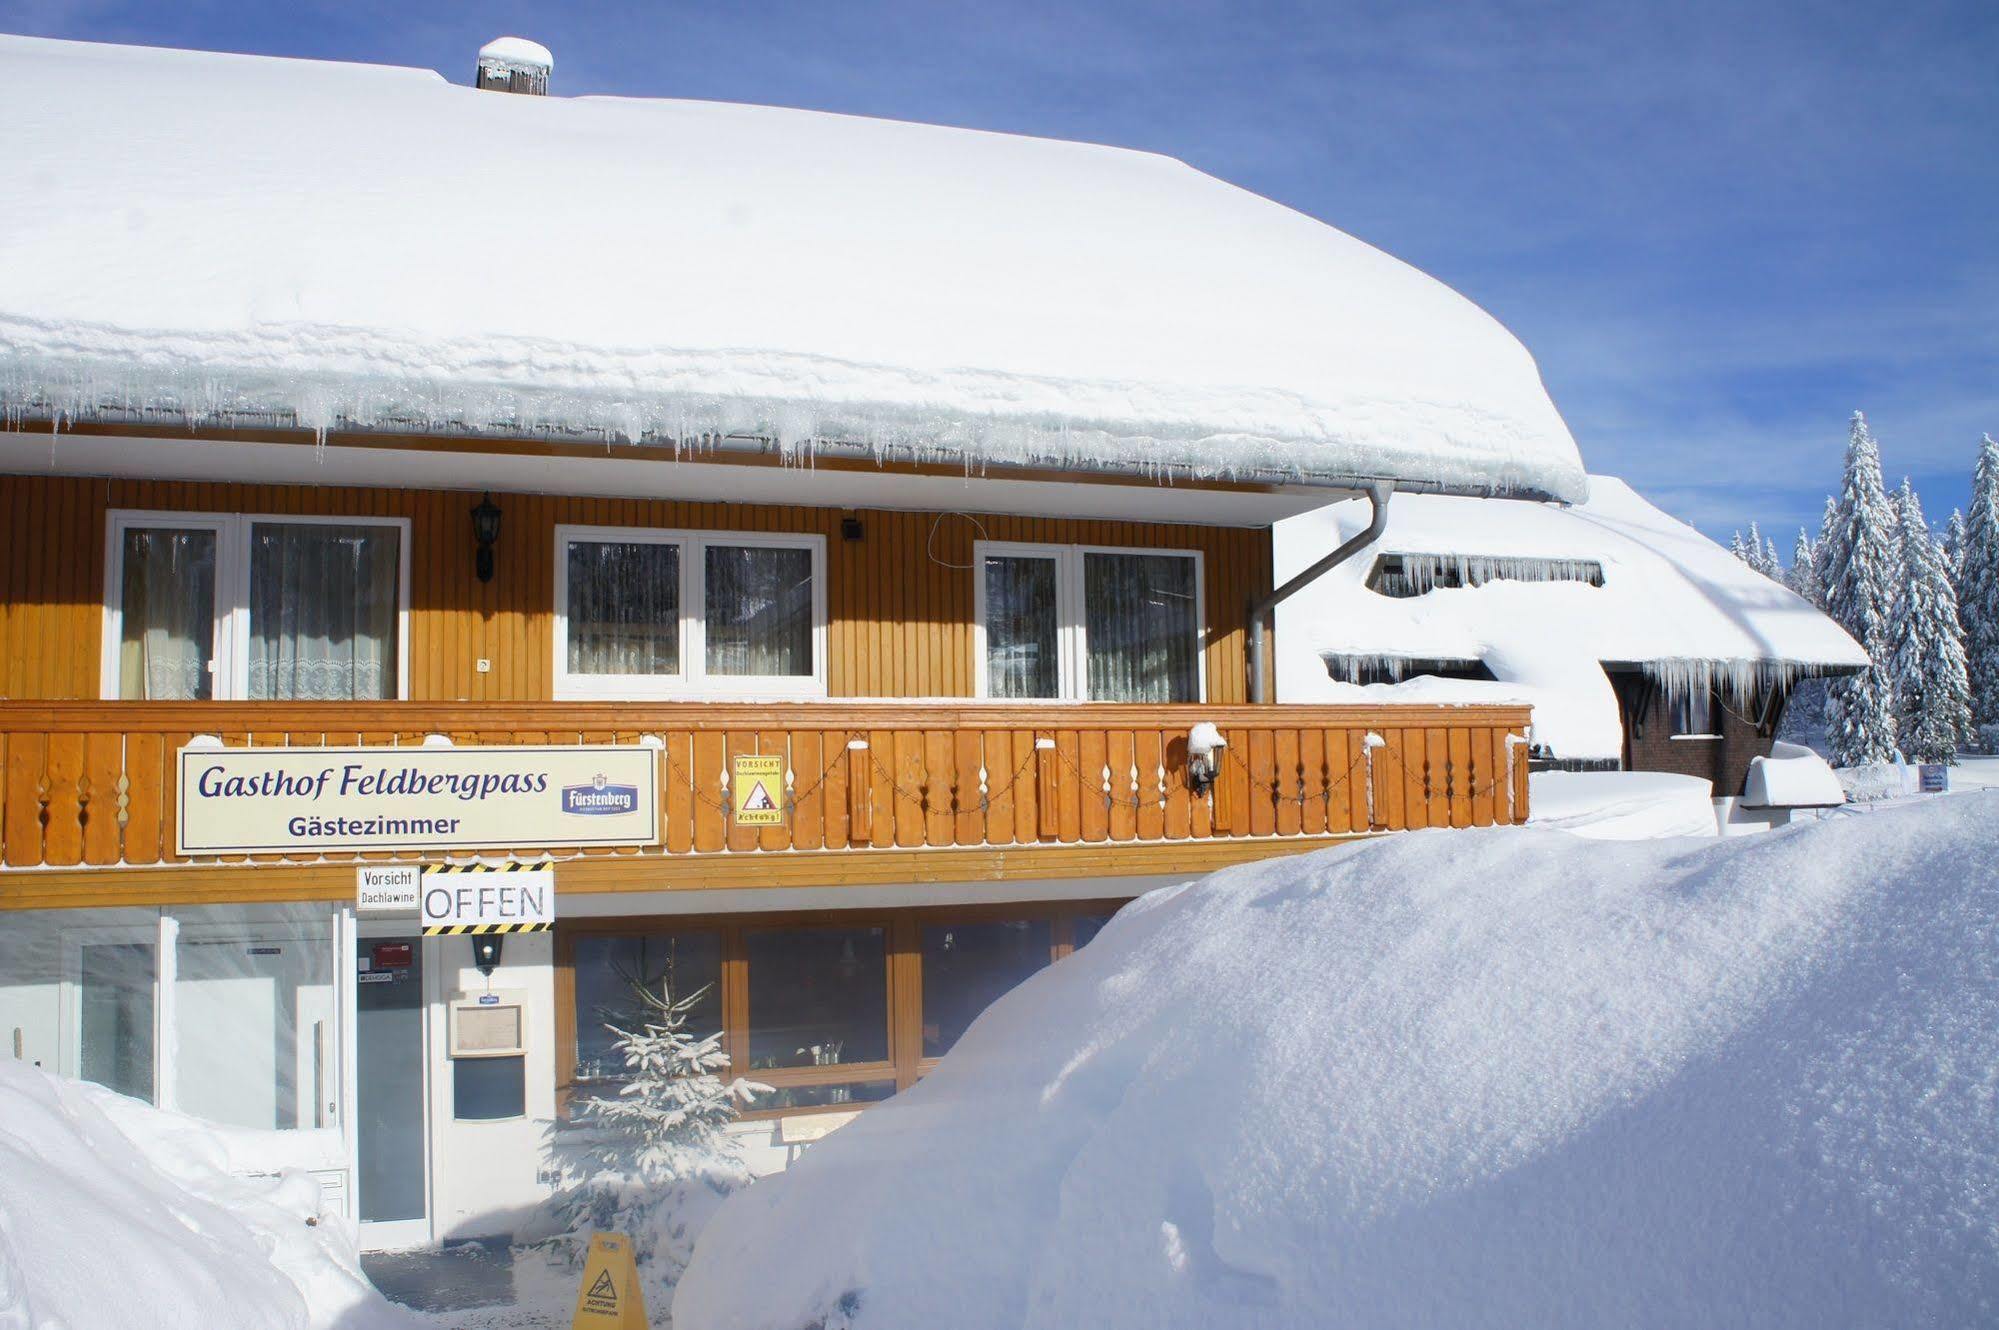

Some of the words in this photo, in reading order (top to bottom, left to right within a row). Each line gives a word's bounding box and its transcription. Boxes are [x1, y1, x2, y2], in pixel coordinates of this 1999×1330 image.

[198, 765, 335, 801] Gasthof
[339, 765, 548, 801] Feldbergpass
[569, 790, 631, 808] Fürstenberg
[738, 812, 780, 821] Achtung!
[288, 815, 461, 837] Gästezimmer
[364, 871, 412, 886] Vorsicht
[361, 891, 415, 904] Dachlawine
[425, 886, 543, 919] OFFEN
